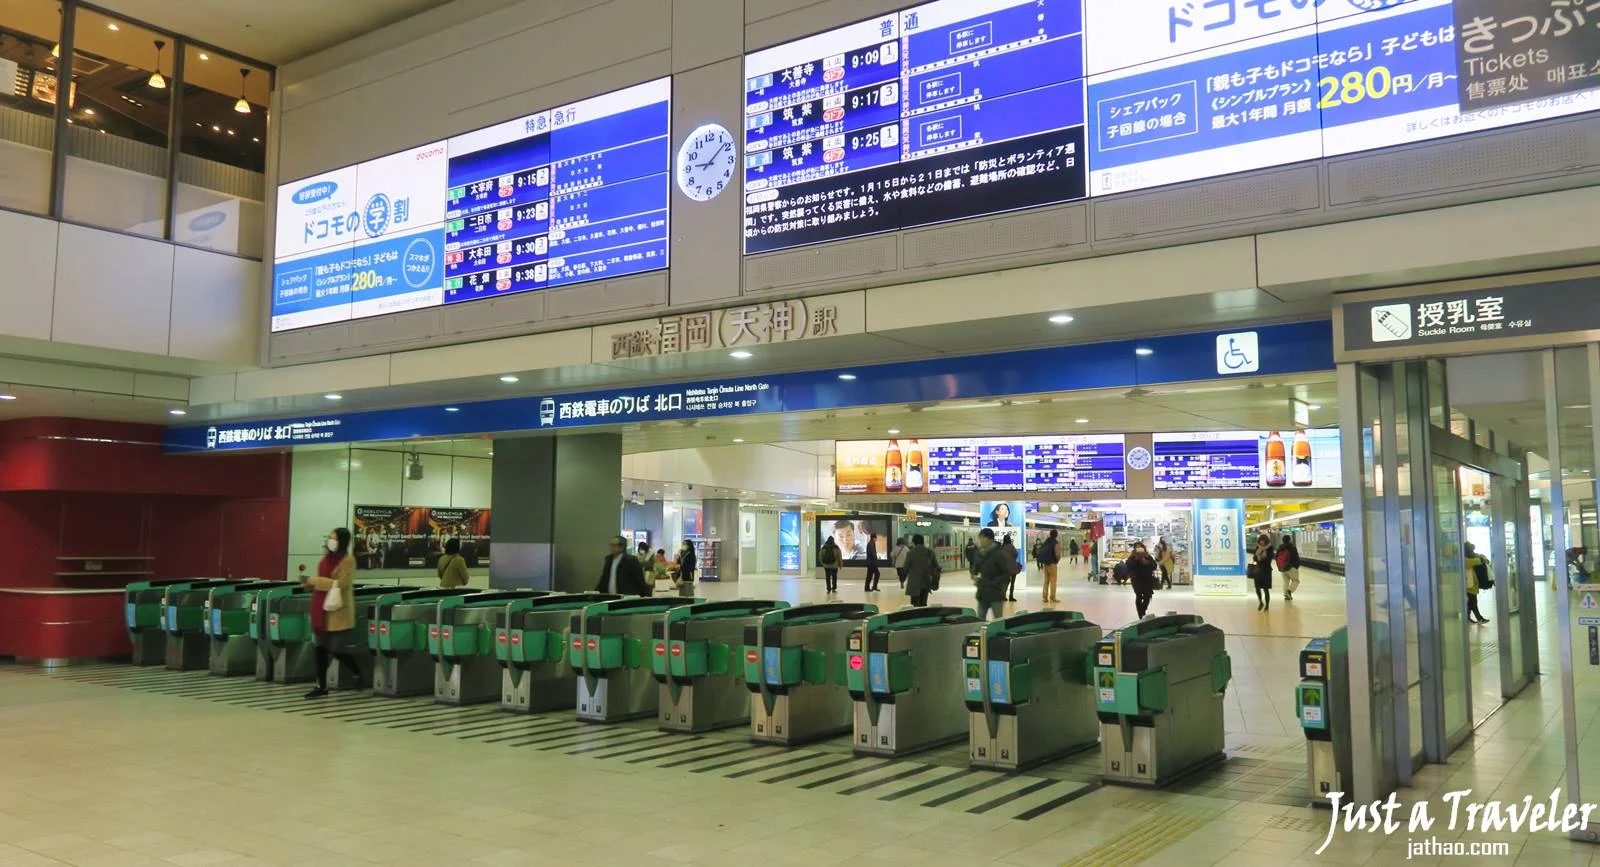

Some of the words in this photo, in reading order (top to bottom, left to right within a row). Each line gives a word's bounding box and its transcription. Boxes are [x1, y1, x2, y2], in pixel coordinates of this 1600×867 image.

[1381, 25, 1455, 56] 子どもは
[781, 63, 814, 83] 大善寺
[852, 50, 879, 68] 9:09
[1464, 48, 1549, 77] Tickets
[1465, 74, 1529, 101] 售票处
[852, 90, 879, 109] 9:17
[1109, 93, 1182, 119] シェアパック
[1211, 105, 1278, 130] 最大1年間
[1283, 98, 1312, 116] 月額
[1107, 112, 1187, 139] 子回線の場合
[695, 140, 703, 149] 11
[705, 133, 714, 143] 12
[719, 134, 723, 143] 1
[852, 132, 880, 150] 9:25
[724, 142, 731, 151] 2
[688, 152, 698, 161] 10
[727, 155, 734, 164] 3
[685, 164, 692, 173] 9
[723, 169, 730, 178] 4
[518, 173, 537, 187] 9:15
[688, 176, 695, 185] 8
[716, 181, 723, 189] 5
[696, 185, 702, 193] 7
[706, 187, 712, 195] 6
[469, 213, 492, 227] 二日市
[516, 208, 535, 221] 9:23
[468, 246, 492, 260] 大牟田
[516, 242, 535, 255] 9:30
[515, 269, 535, 282] 9:38
[1417, 296, 1505, 328] 授乳室
[1449, 324, 1475, 335] Room
[559, 395, 650, 420] 西鉄電車のりば
[654, 394, 682, 412] 北口
[218, 426, 273, 444] 西鉄電車のりば
[274, 425, 291, 440] 北口
